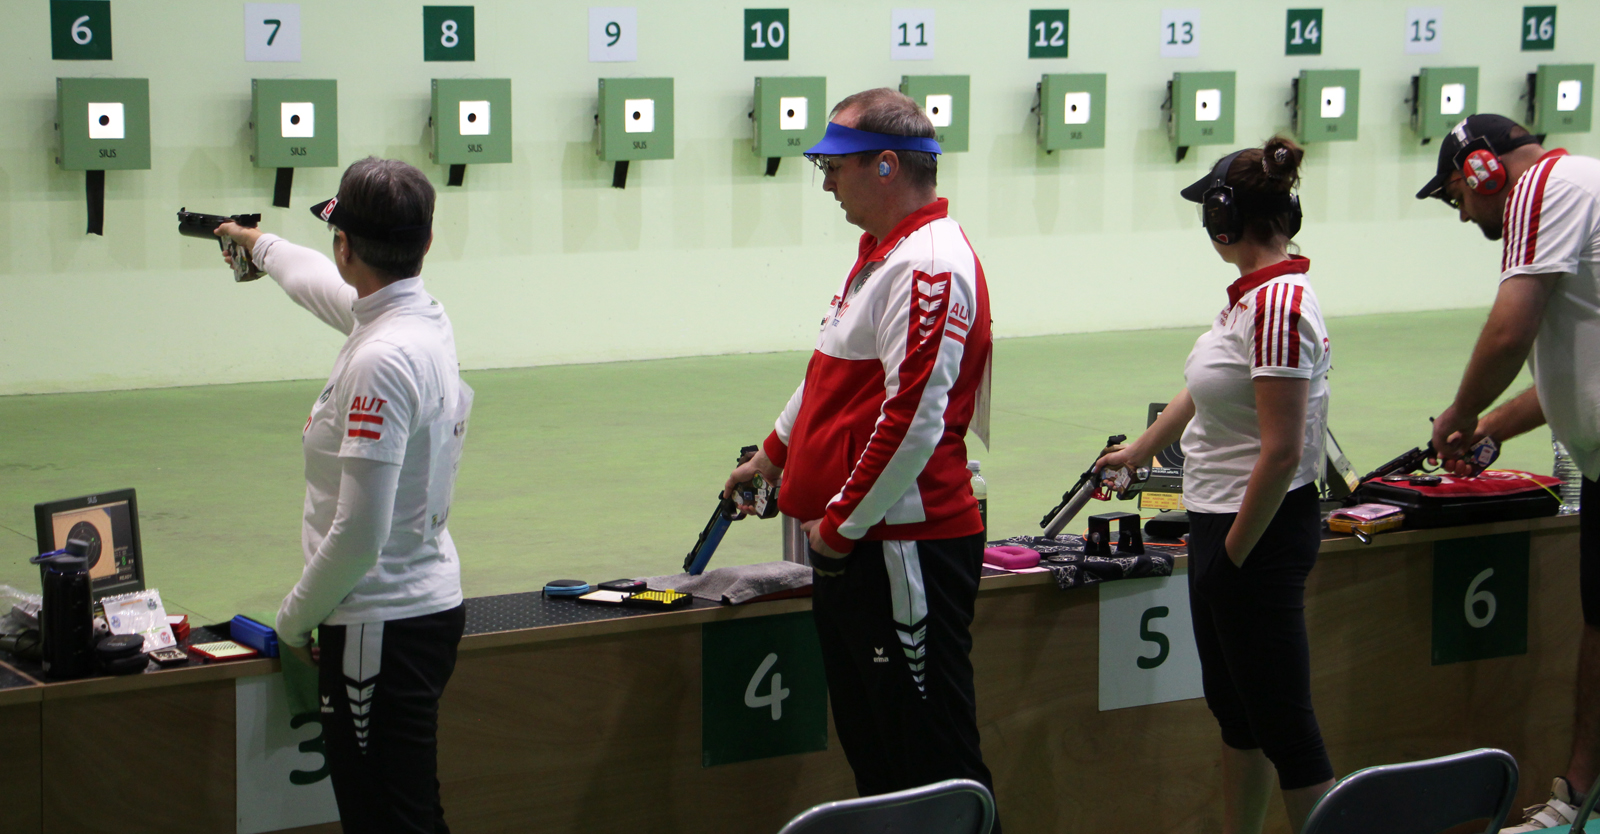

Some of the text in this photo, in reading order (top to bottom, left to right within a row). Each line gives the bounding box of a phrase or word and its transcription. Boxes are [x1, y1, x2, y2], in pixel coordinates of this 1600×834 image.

[71, 15, 93, 45] 6
[263, 19, 282, 47] 7
[440, 20, 459, 48] 8
[605, 21, 622, 47] 9
[751, 22, 785, 48] 10
[898, 22, 928, 47] 11
[1035, 21, 1065, 47] 12
[1168, 21, 1194, 45] 13
[1291, 20, 1320, 45] 14
[1411, 19, 1437, 42] 15
[1526, 16, 1554, 41] 16
[98, 148, 117, 158] SIUS
[290, 147, 307, 156] SIUS
[467, 144, 482, 153] SIUS
[632, 140, 647, 150] SIUS
[787, 137, 801, 146] SIUS
[350, 396, 388, 414] AUT
[1463, 567, 1497, 629] 6
[1136, 605, 1170, 670] 5
[744, 652, 791, 721] 4
[289, 711, 332, 786] 3
